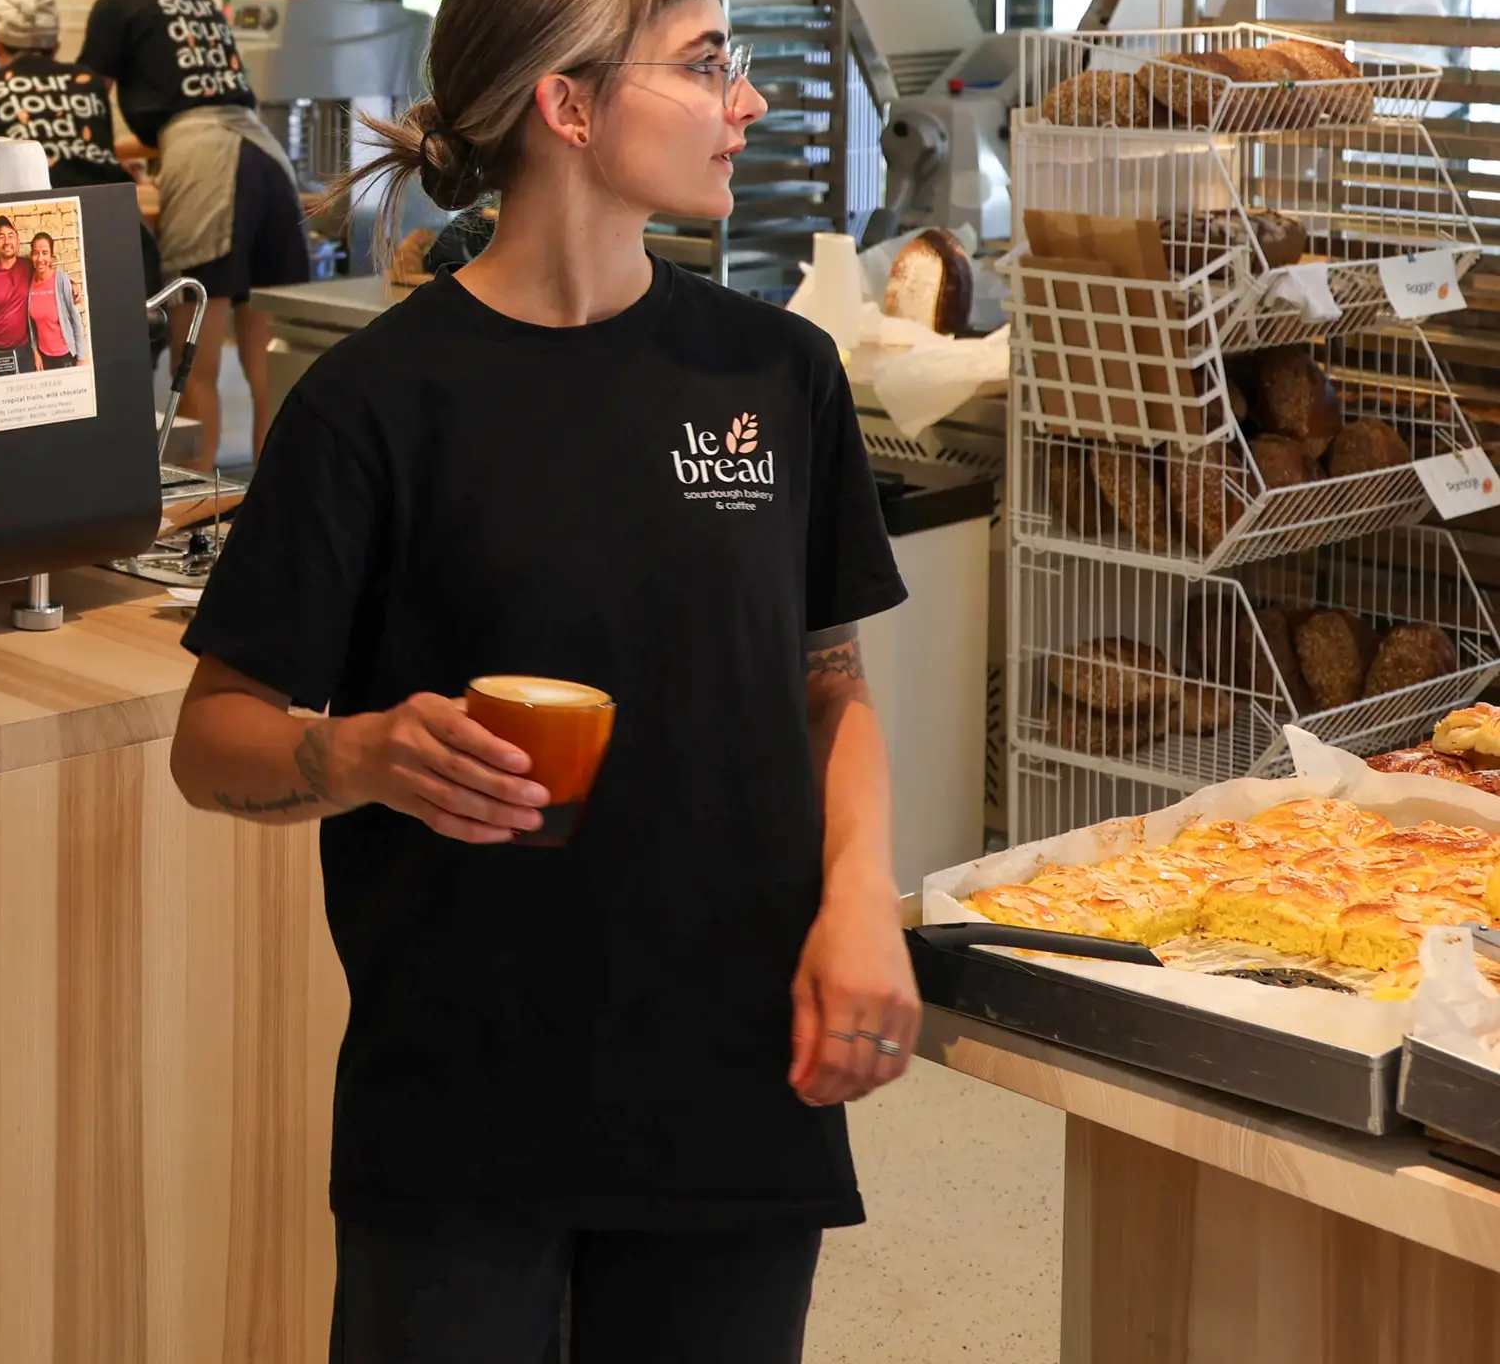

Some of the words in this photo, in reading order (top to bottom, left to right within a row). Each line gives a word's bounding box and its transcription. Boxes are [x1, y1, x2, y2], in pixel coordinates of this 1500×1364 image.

[168, 16, 233, 46] doug
[5, 113, 77, 140] and
[42, 138, 120, 165] offee
[1, 395, 26, 405] tropical
[59, 387, 88, 397] chocolate
[682, 421, 720, 456] le
[669, 450, 775, 486] bread
[683, 489, 744, 500] sourdough
[744, 489, 774, 502] bakery
[715, 501, 725, 510] &
[725, 501, 757, 511] coffee
